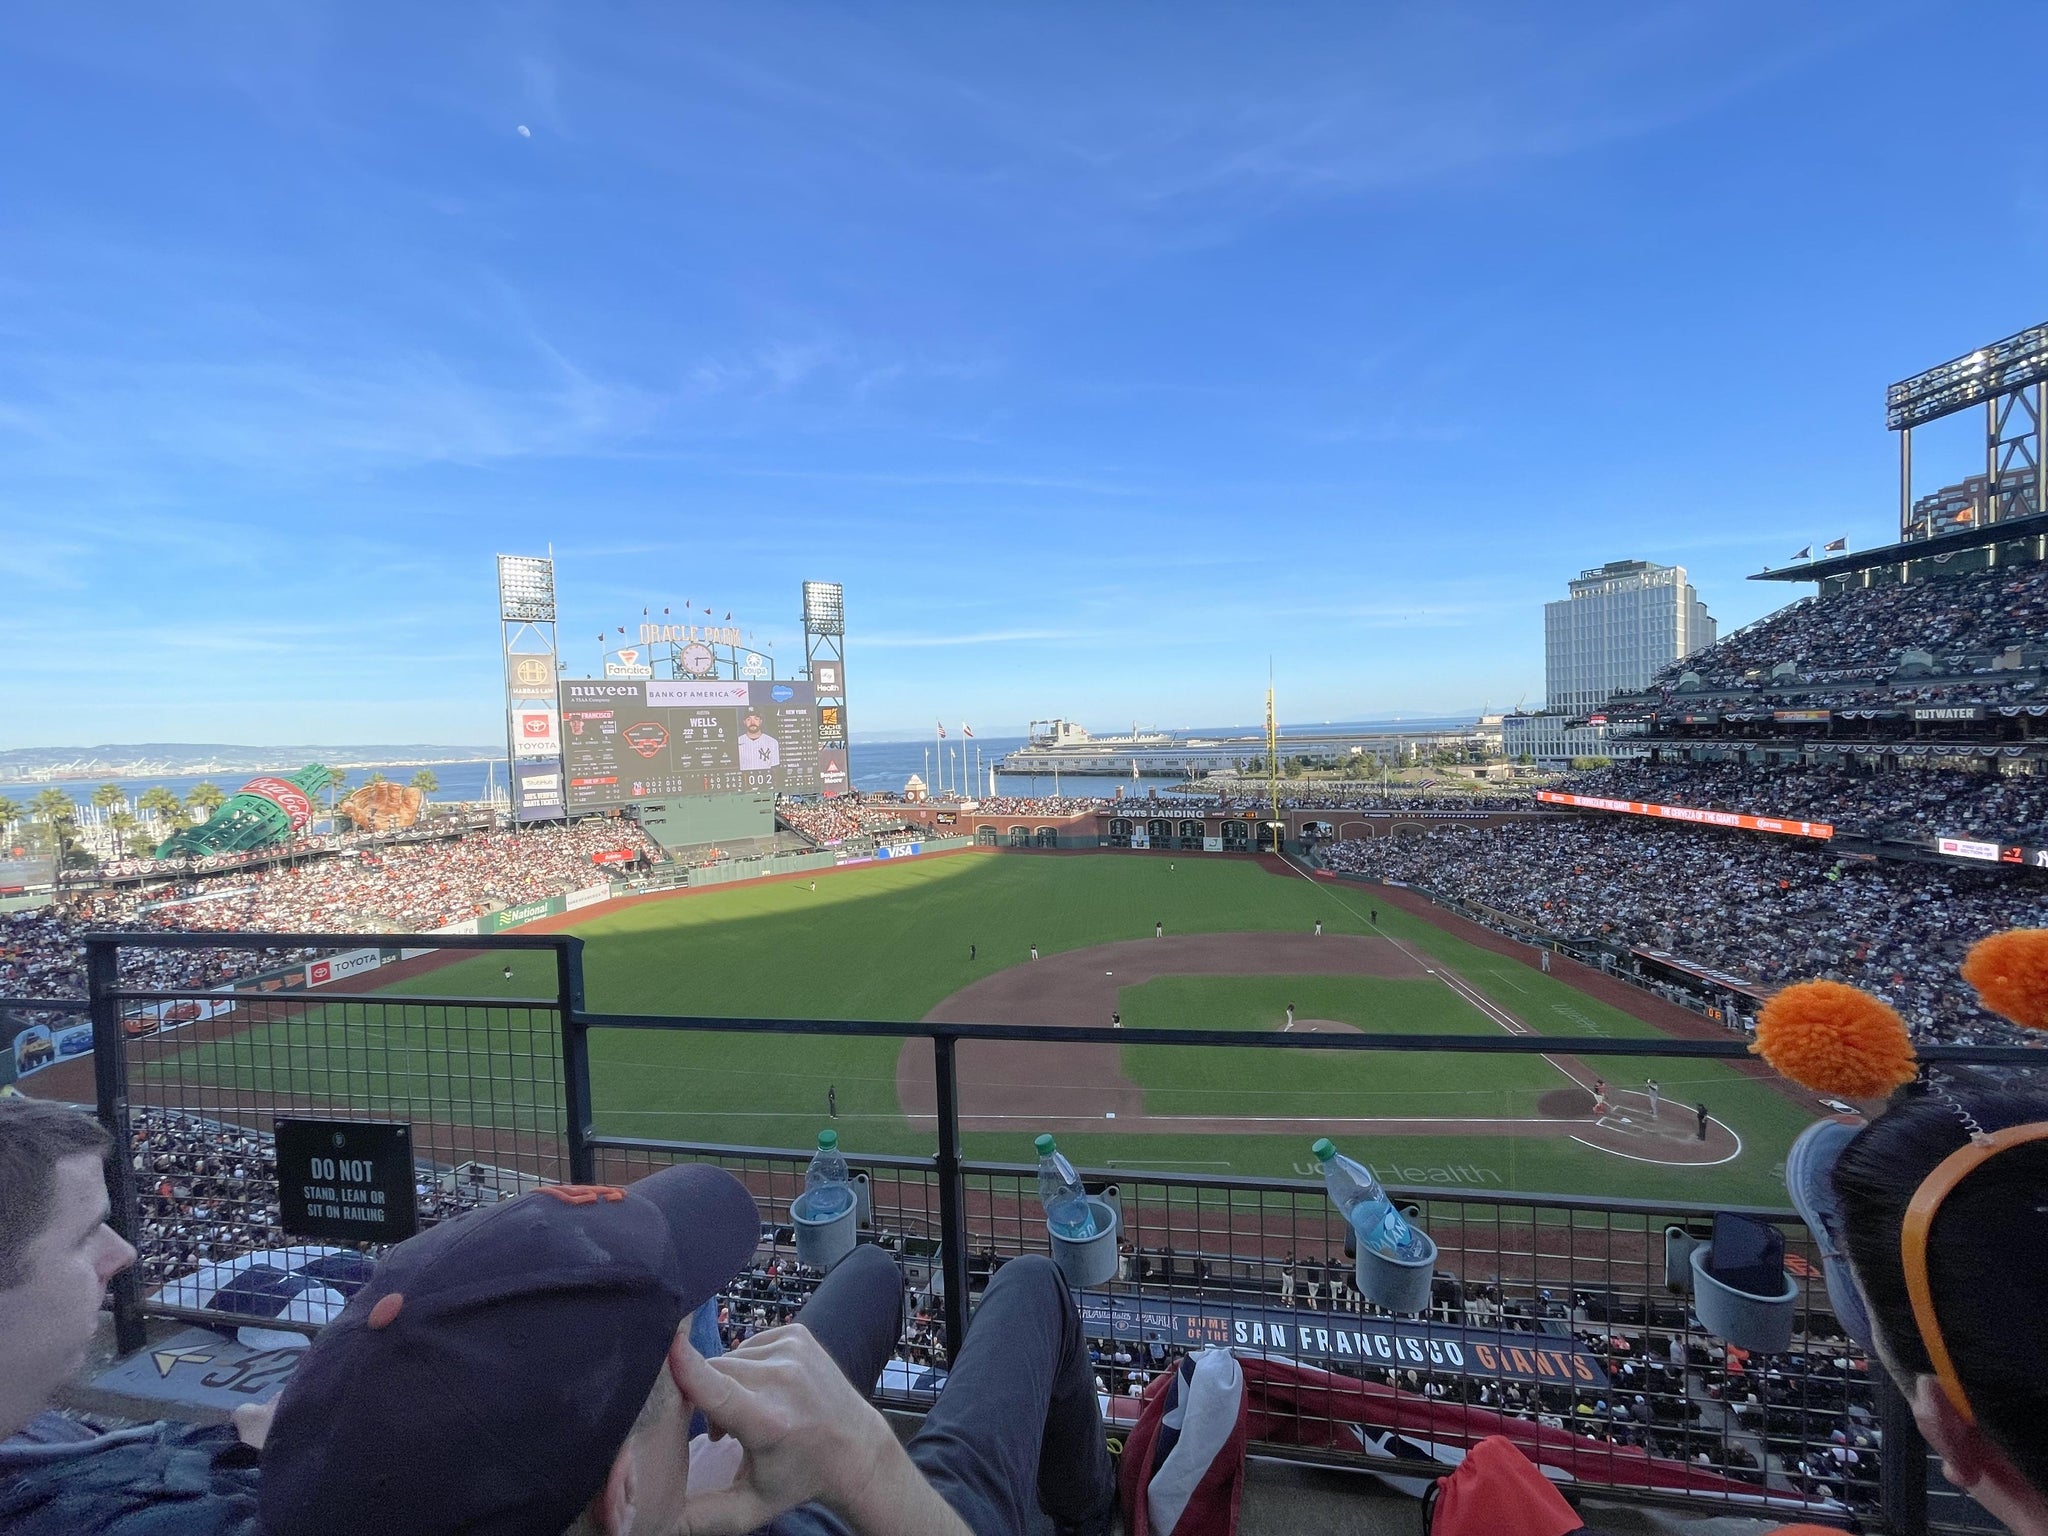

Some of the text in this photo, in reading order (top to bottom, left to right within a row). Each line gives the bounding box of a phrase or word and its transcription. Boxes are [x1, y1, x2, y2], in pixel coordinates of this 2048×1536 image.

[640, 624, 742, 647] ORACLE PARK
[608, 665, 650, 675] Fanatics
[743, 668, 766, 676] coupa
[570, 686, 638, 696] nuveen
[1915, 708, 1975, 719] CUTWATER
[690, 718, 717, 727] WELLS
[518, 742, 556, 750] TOYOTA
[749, 774, 772, 785] 0 0 2
[1150, 809, 1204, 818] LANDING
[1660, 806, 1782, 830] THE CERVEZA OF THE GIANTS Corona
[887, 845, 912, 858] VISA
[512, 902, 548, 921] National
[334, 953, 377, 972] TOYOTA
[311, 1158, 373, 1182] DO NOT
[1369, 1163, 1502, 1182] Health
[304, 1186, 385, 1204] STAND, LEAN OR
[307, 1204, 385, 1222] SIT ON RAILING
[1188, 1317, 1228, 1330] HOME
[1188, 1329, 1228, 1342] OF THE
[1235, 1321, 1594, 1381] SAN FRANCISCO GIANTS
